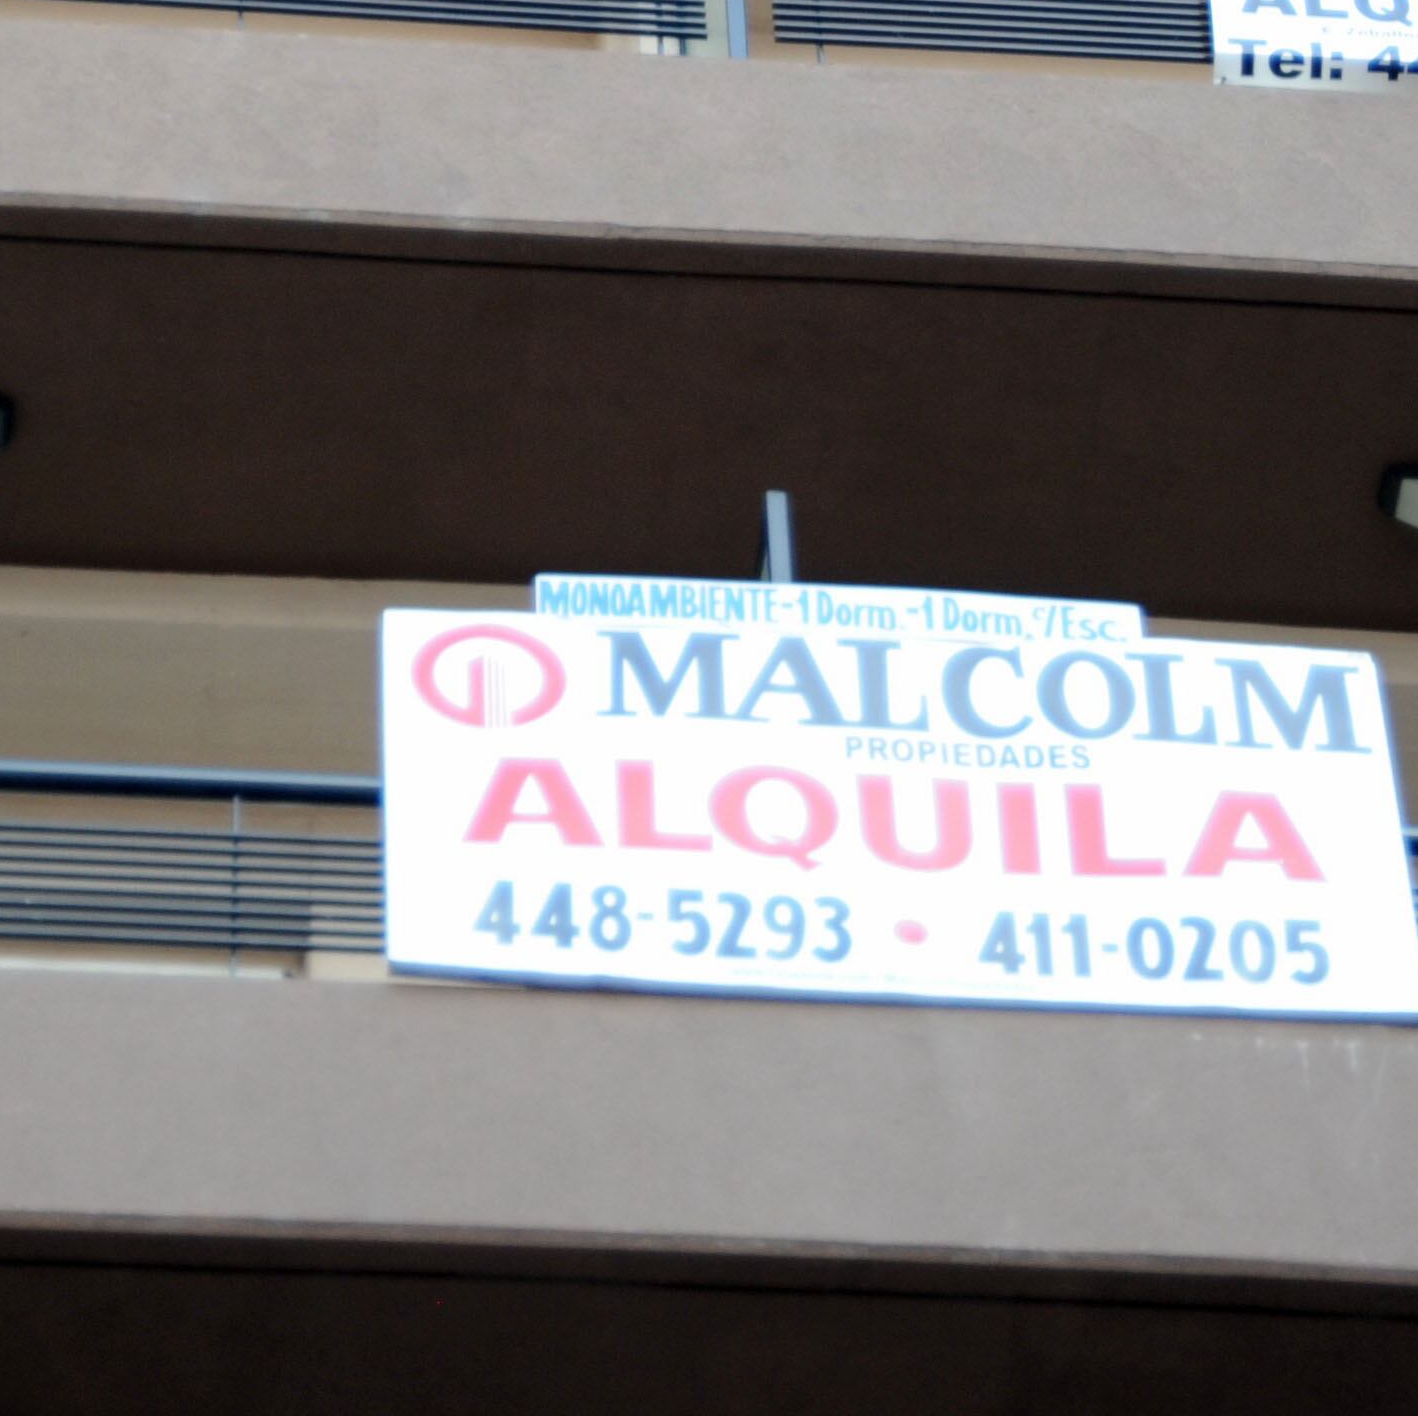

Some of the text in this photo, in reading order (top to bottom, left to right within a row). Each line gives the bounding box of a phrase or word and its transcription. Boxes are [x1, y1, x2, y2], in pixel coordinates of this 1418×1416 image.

[1228, 37, 1344, 80] Tel:
[595, 629, 1373, 754] MALCOLM
[844, 735, 1091, 770] PROPIEDADES
[461, 757, 1327, 883] ALQUILA
[473, 880, 1331, 985] 448-5293 411-0205
